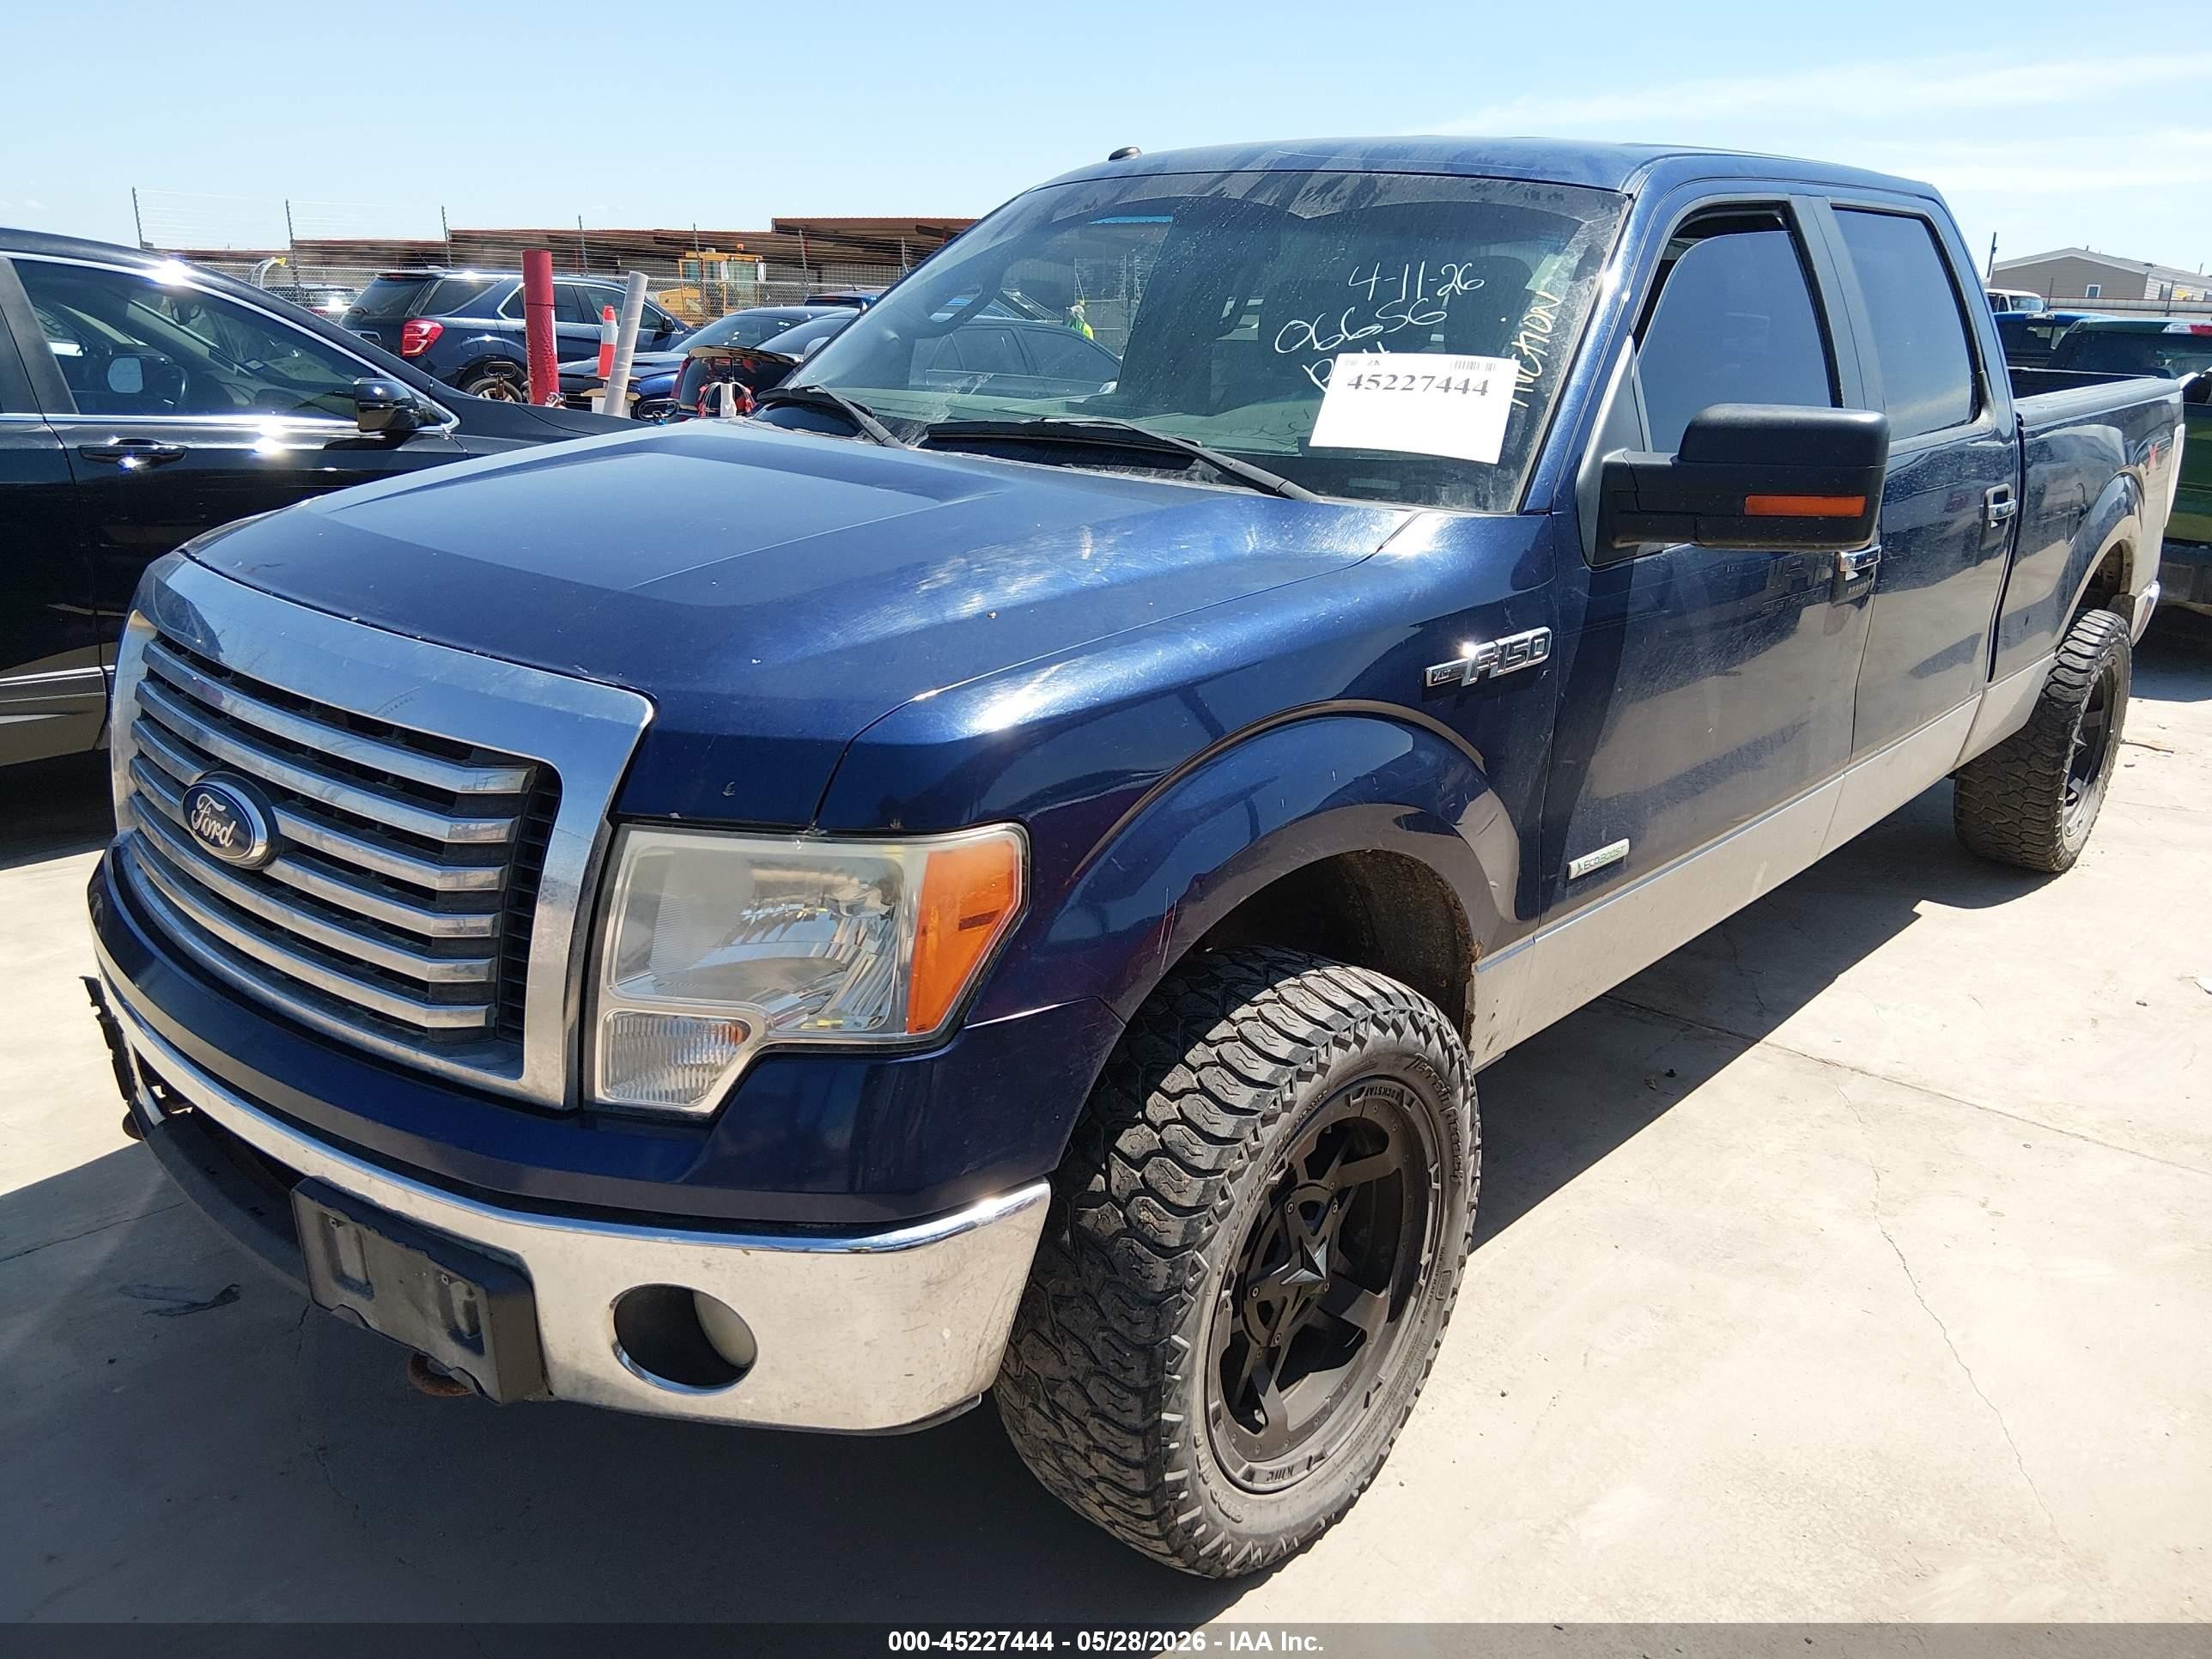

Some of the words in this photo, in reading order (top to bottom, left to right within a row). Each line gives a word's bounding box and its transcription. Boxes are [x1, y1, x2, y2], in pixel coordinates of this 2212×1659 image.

[1348, 261, 1485, 301] 4-11-26
[1347, 374, 1489, 397] 45227444
[191, 793, 237, 848] Ford
